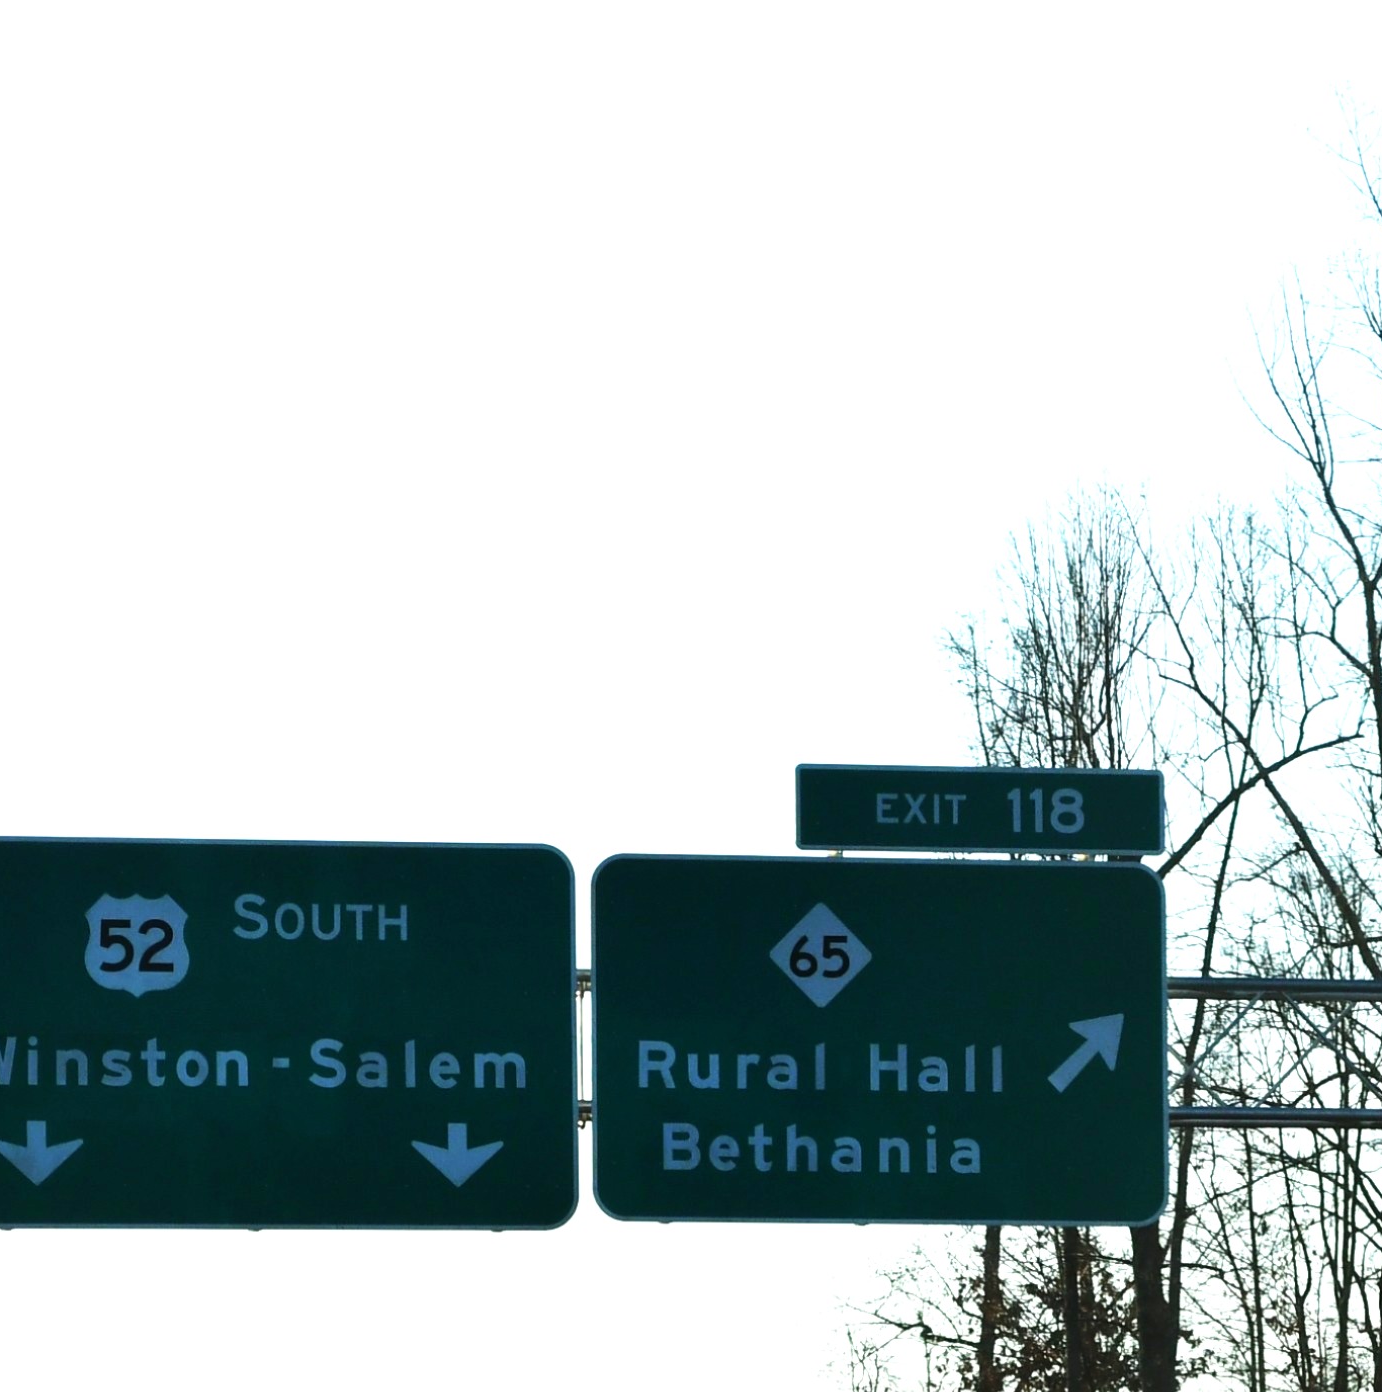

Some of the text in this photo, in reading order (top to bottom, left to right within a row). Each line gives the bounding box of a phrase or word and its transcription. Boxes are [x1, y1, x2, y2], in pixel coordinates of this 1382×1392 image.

[876, 787, 1086, 834] EXIT 118
[232, 893, 409, 942] SOUTH
[99, 918, 174, 973] 52
[789, 934, 850, 979] 65
[638, 1039, 1004, 1093] Rural Hall
[662, 1122, 982, 1174] Bethania
